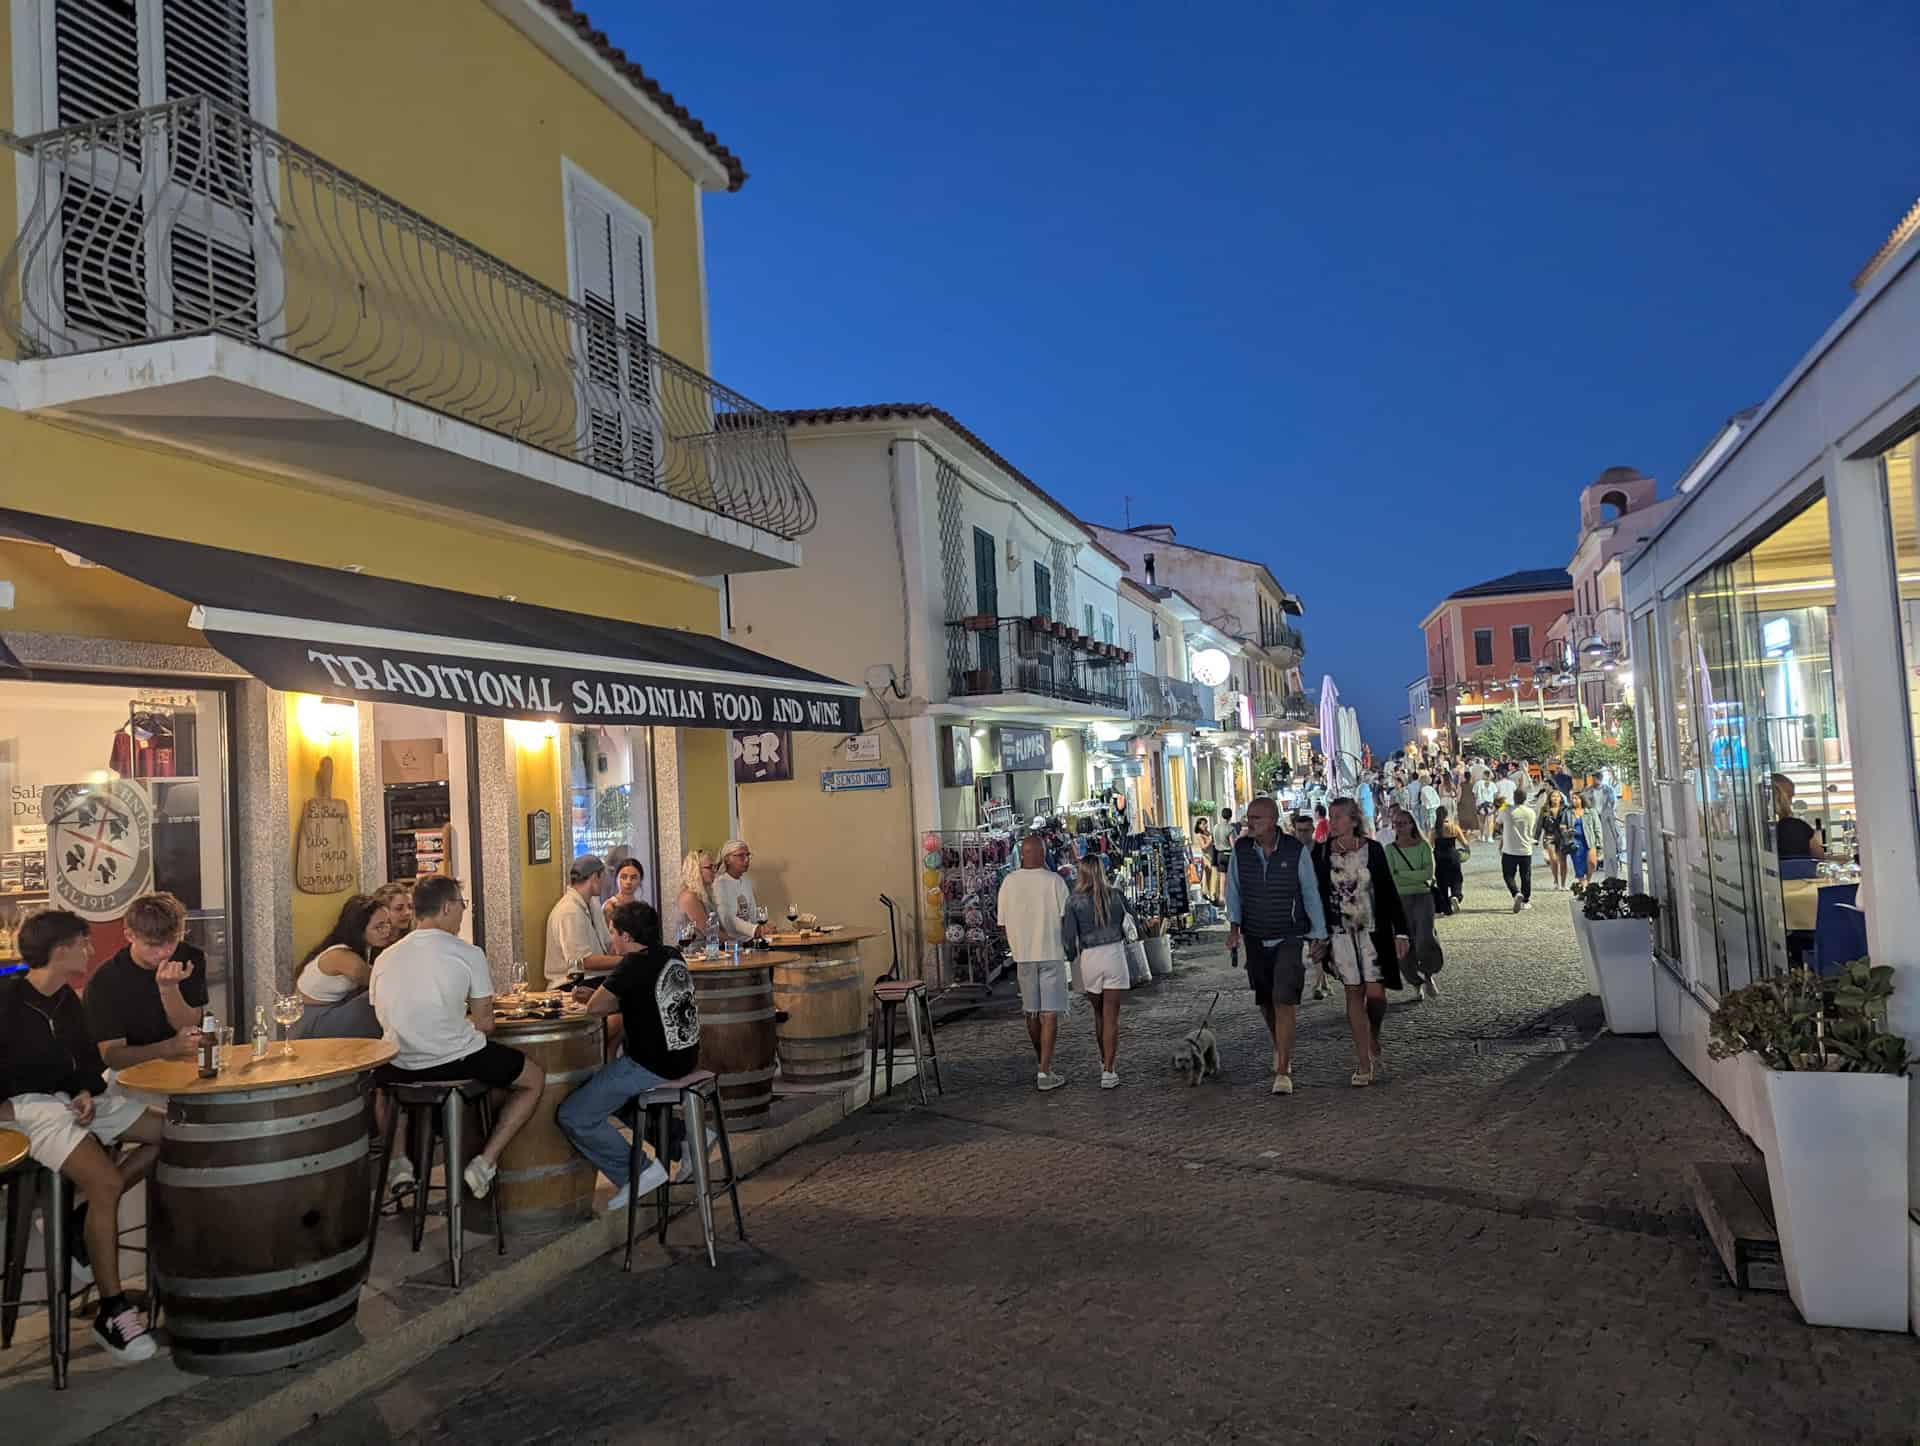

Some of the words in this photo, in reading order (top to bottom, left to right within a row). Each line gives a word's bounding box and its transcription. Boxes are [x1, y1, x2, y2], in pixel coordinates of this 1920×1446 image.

[307, 649, 563, 713] TRADITIONAL
[571, 680, 706, 720] SARDINIAN
[713, 691, 762, 721] FOOD
[773, 697, 804, 723] AND
[807, 700, 841, 726] WINE
[834, 773, 863, 786] SENSO
[864, 771, 887, 785] UNICO
